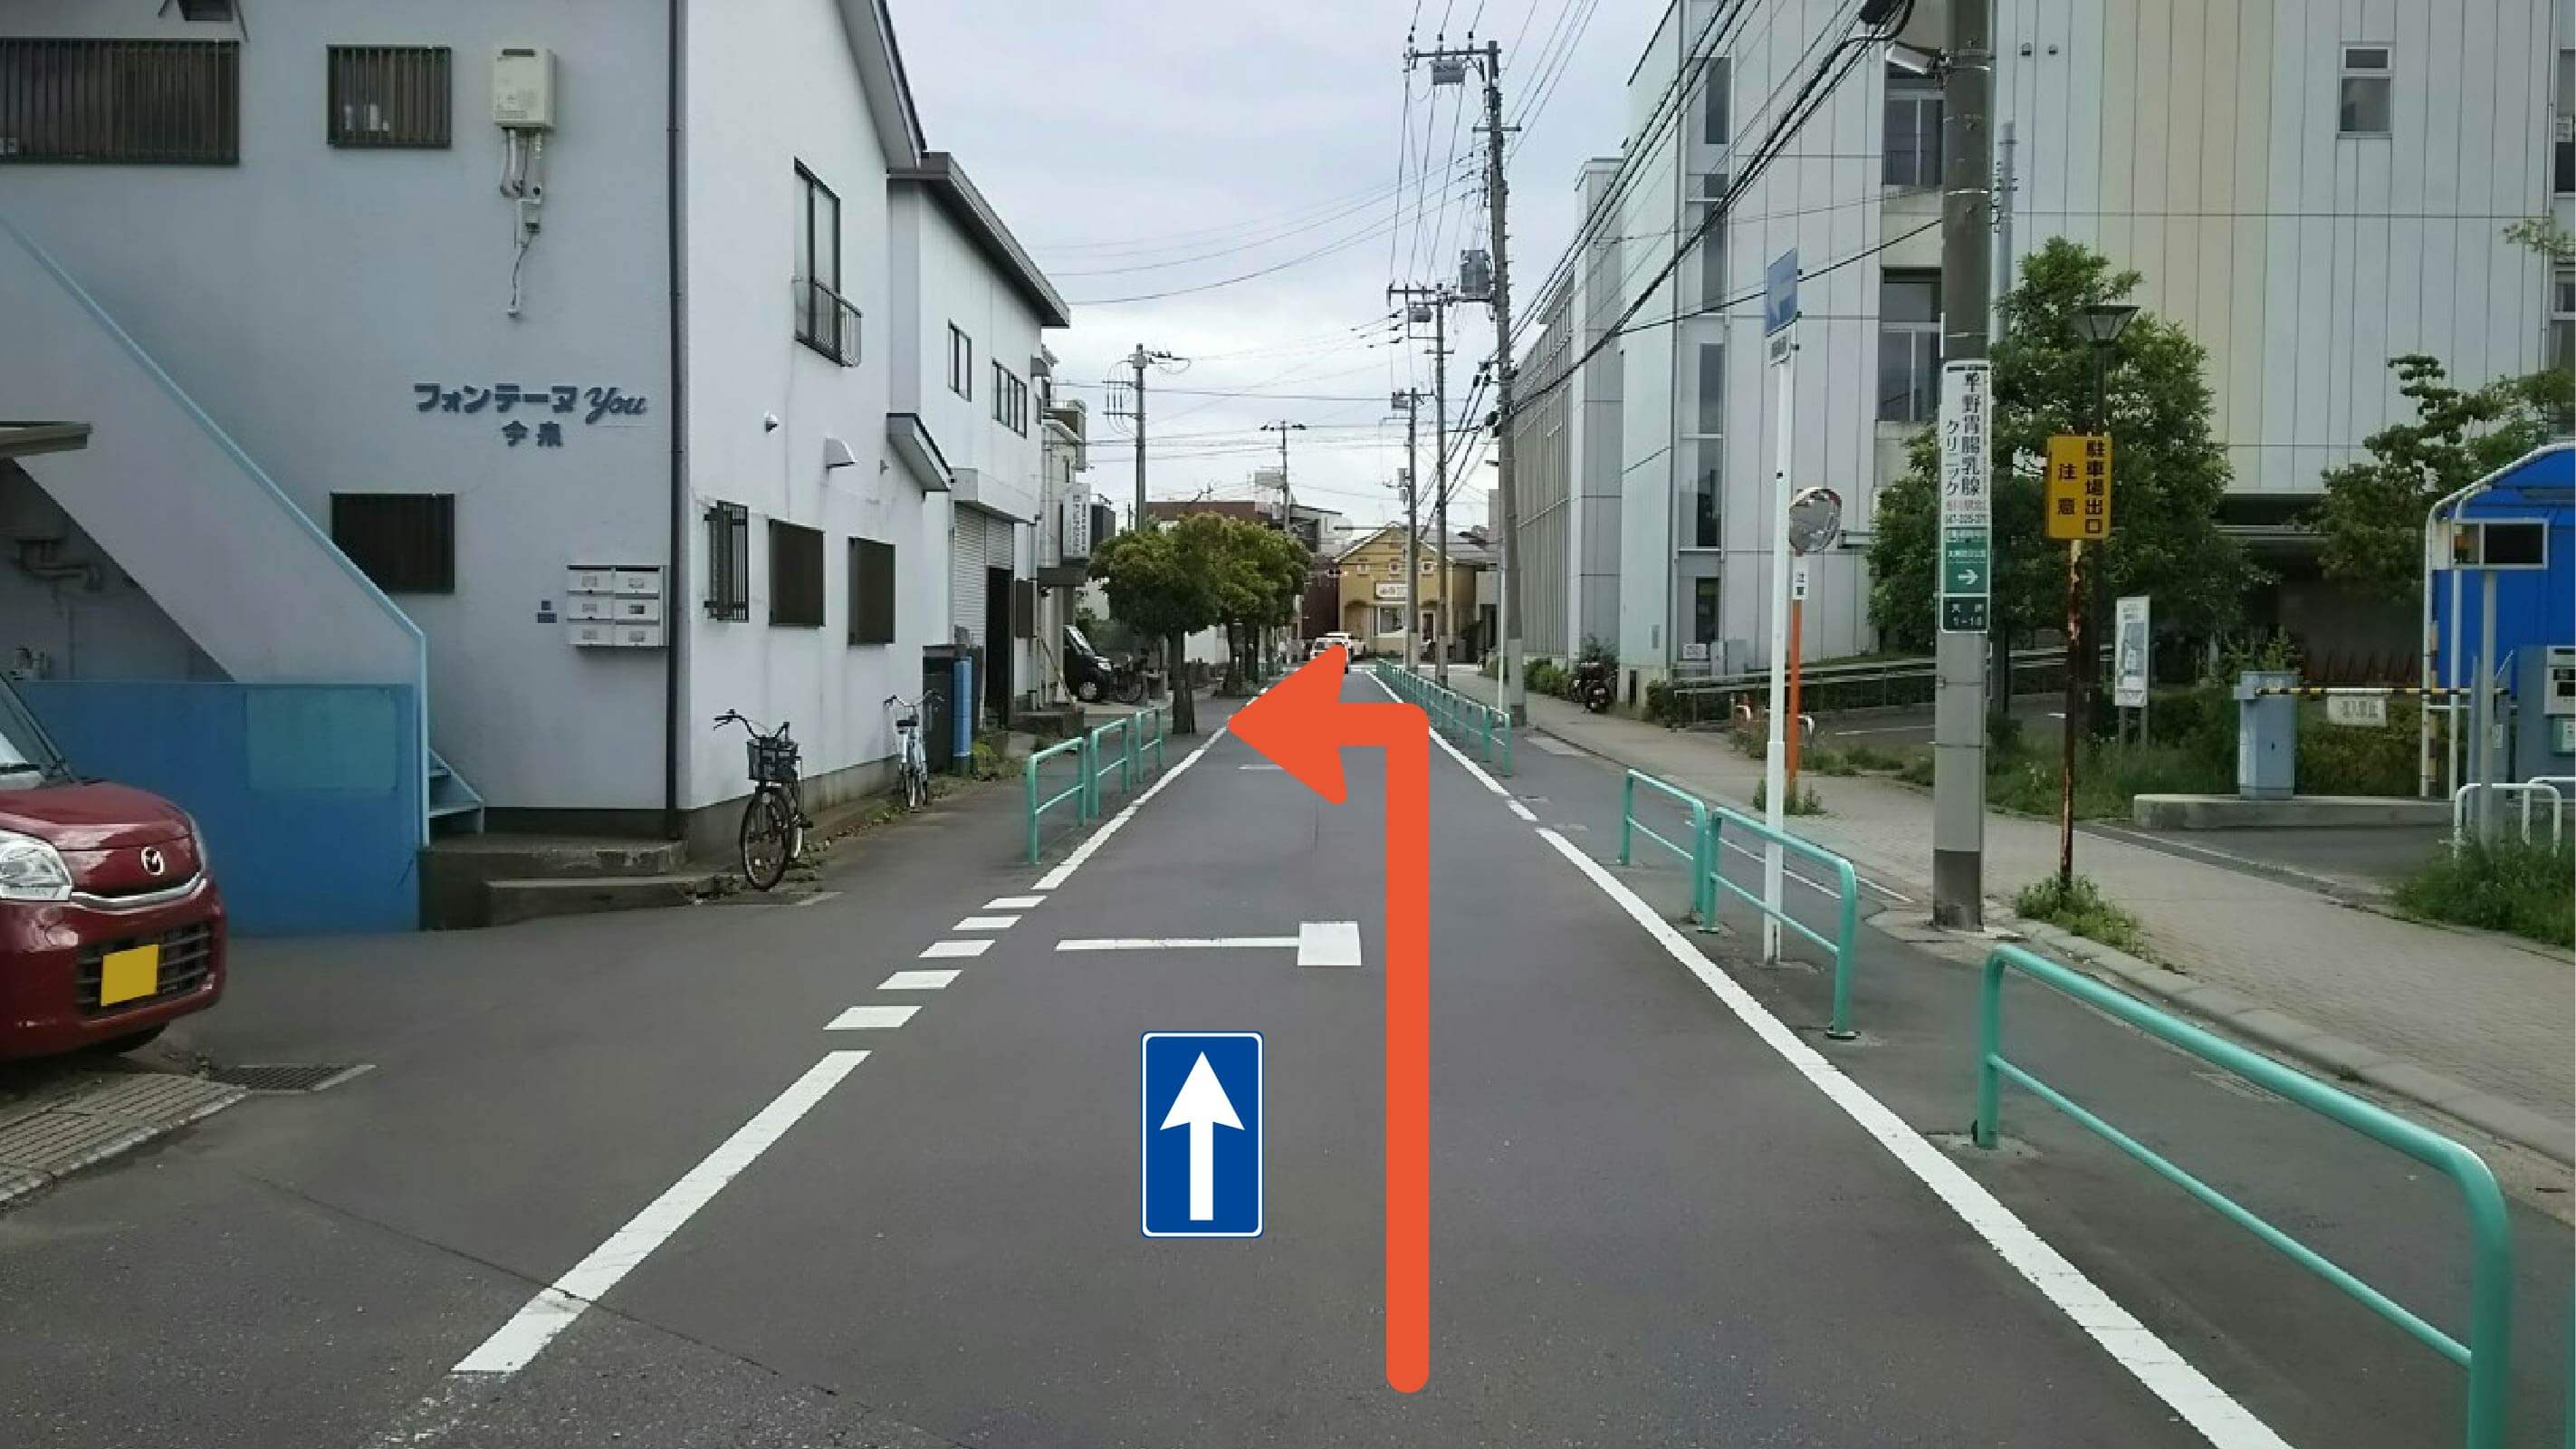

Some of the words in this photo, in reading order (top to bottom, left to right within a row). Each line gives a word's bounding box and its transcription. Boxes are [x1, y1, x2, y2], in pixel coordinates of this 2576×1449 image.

[414, 382, 579, 414] フォンテーヌ
[583, 386, 648, 426] You
[1946, 418, 1960, 496] クリニック
[2057, 463, 2078, 515] 注意
[2084, 439, 2105, 534] 駐車場出口
